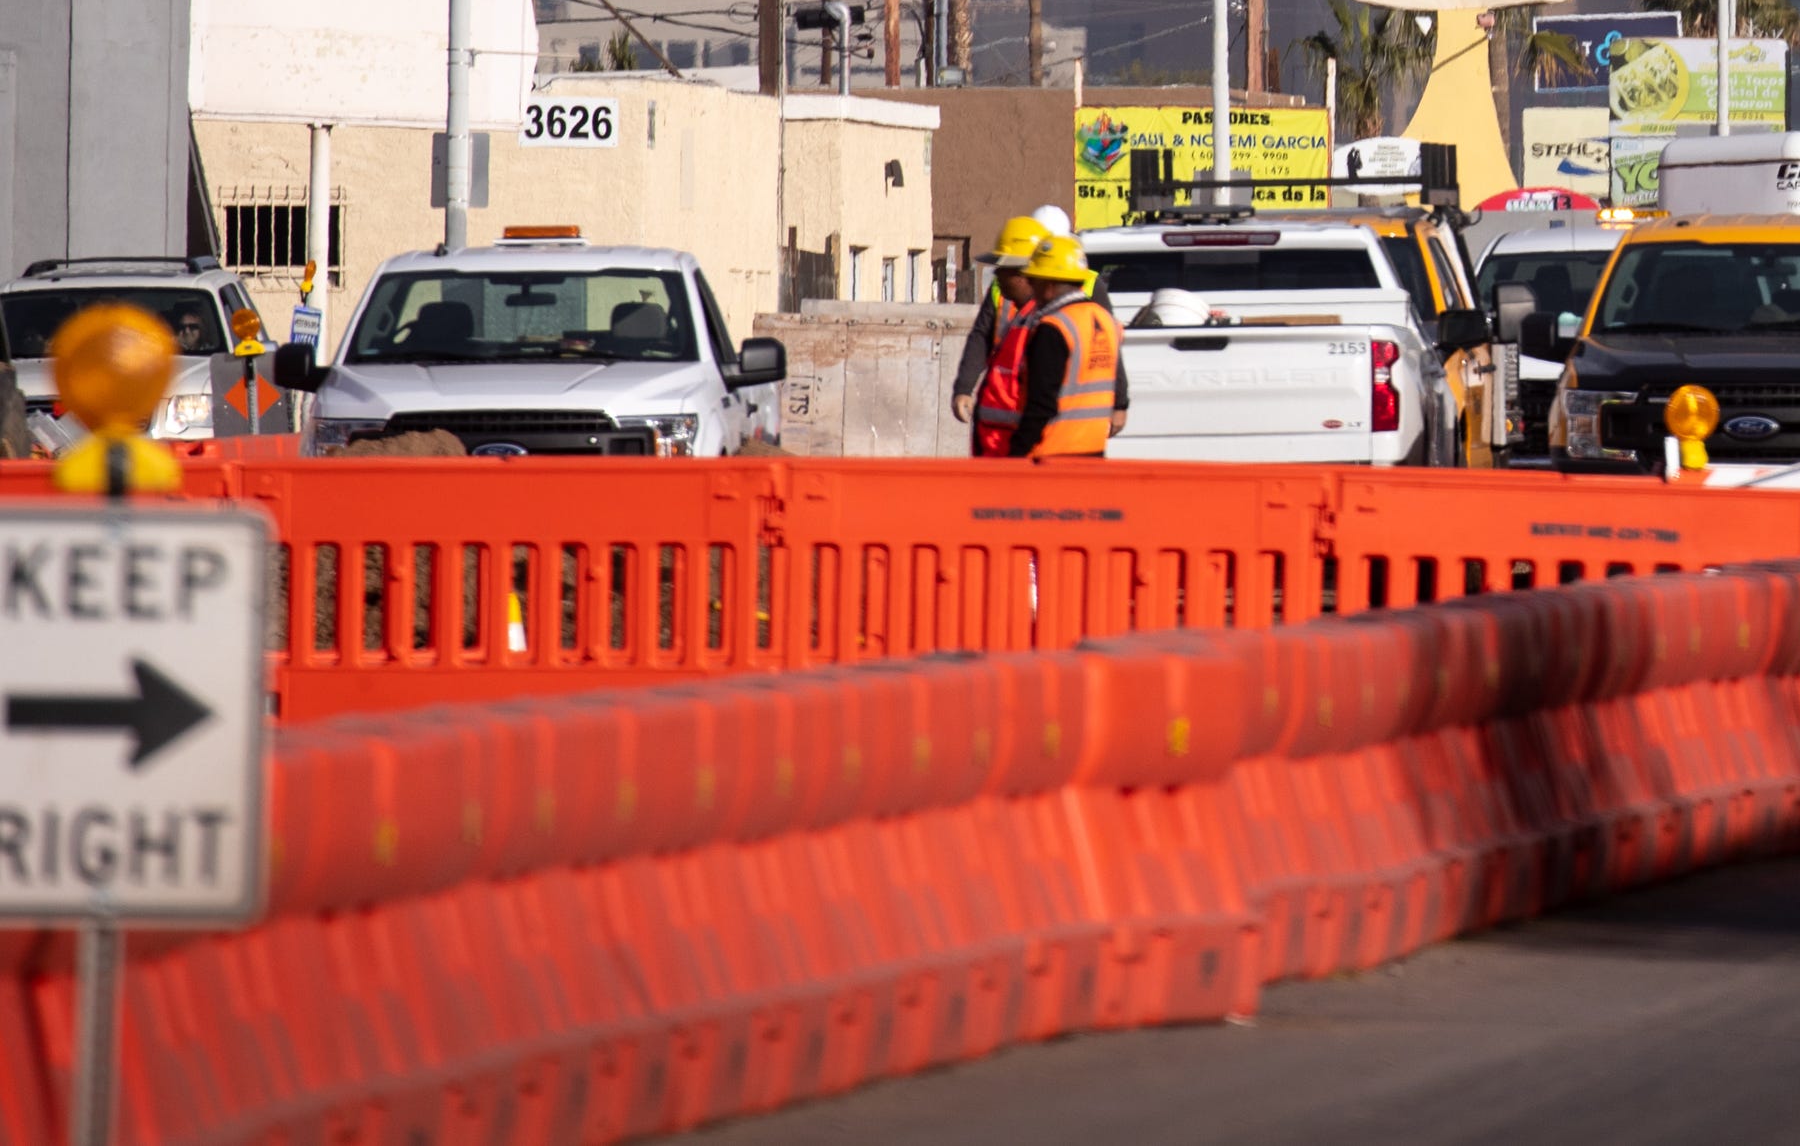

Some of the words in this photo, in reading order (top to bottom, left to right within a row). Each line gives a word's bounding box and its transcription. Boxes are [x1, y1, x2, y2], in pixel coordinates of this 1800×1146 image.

[524, 104, 613, 141] 3626
[1181, 111, 1271, 126] PASORES
[1129, 134, 1164, 147] SAUL
[1172, 134, 1185, 147] &
[1190, 134, 1257, 149] NOEMI
[1261, 135, 1327, 150] GARCIA
[1282, 186, 1303, 201] de
[1310, 185, 1326, 201] la
[1327, 341, 1367, 356] 2153
[4, 540, 229, 621] KEEP
[0, 807, 231, 888] RIGHT
